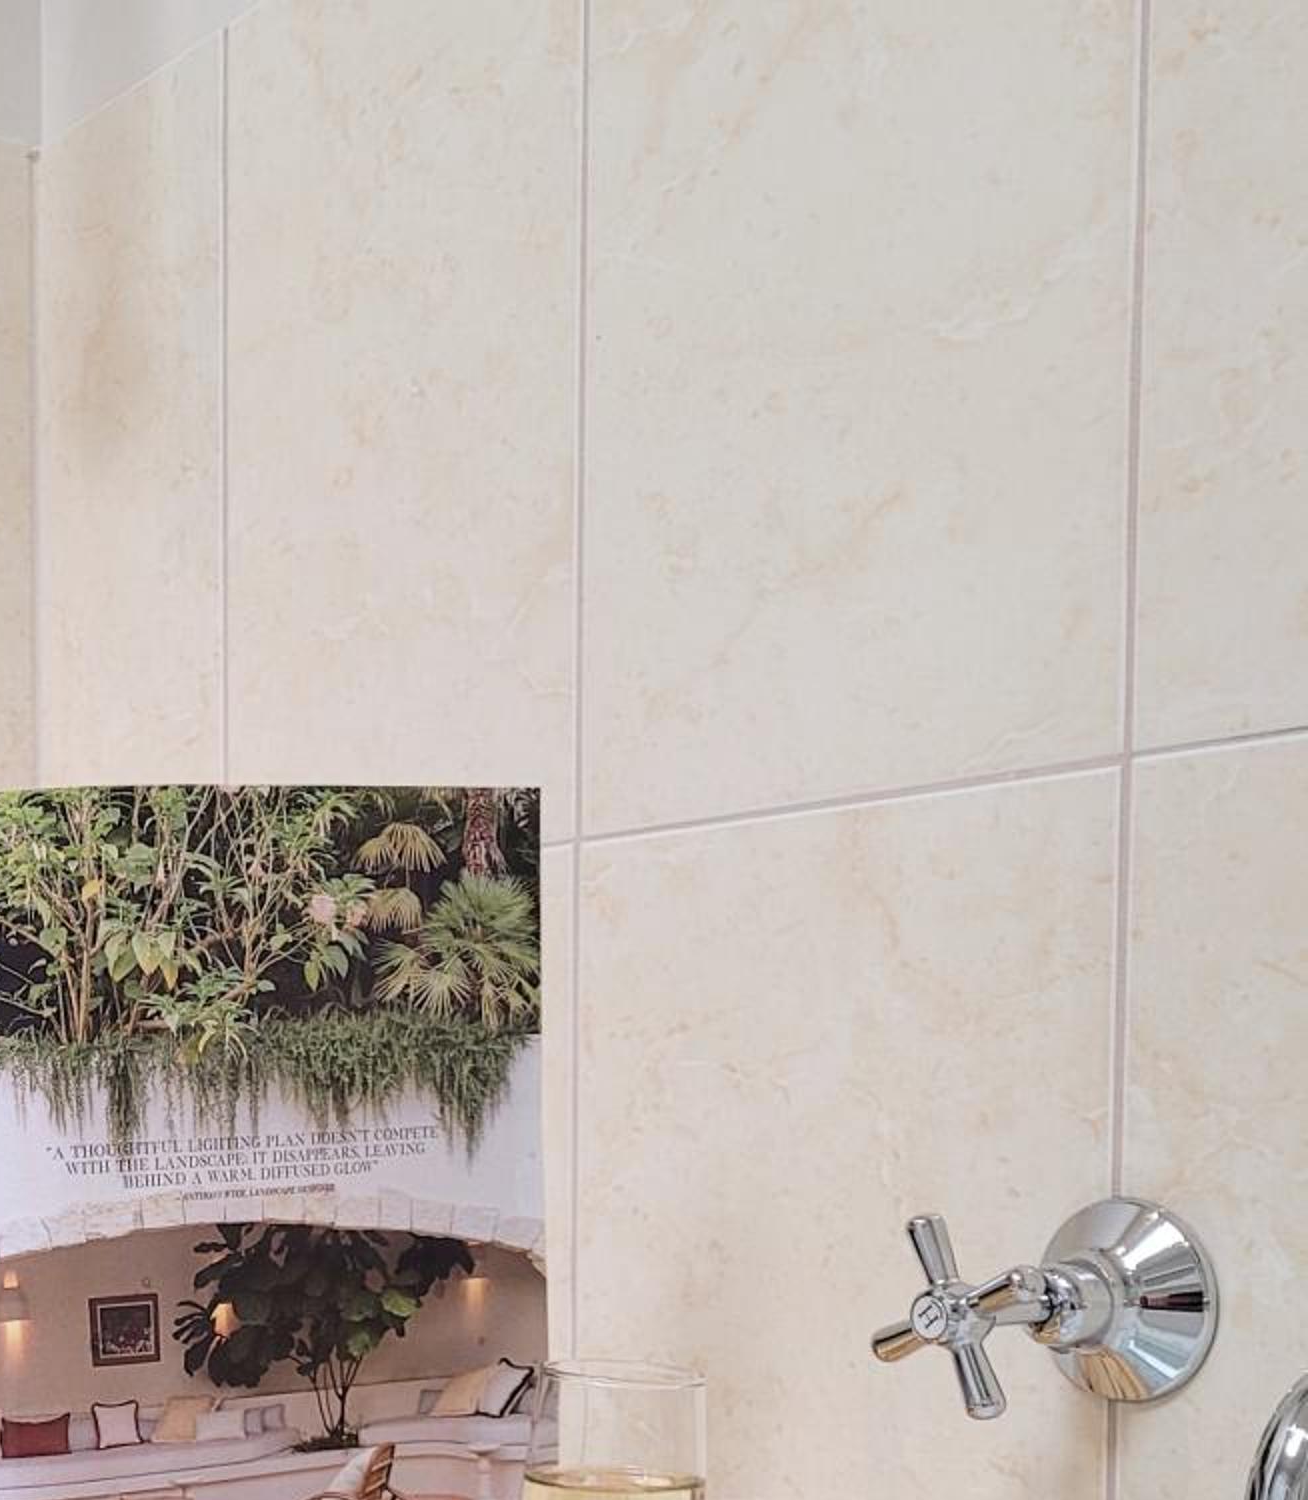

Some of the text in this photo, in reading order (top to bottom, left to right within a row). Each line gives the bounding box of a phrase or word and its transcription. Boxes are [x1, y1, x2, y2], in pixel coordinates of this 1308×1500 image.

[70, 1139, 182, 1159] THOUGHTFUL
[189, 1134, 261, 1153] LIGHTING
[265, 1132, 305, 1148] PLAN
[310, 1129, 370, 1146] DOESN'T
[373, 1126, 437, 1142] COMPETE
[65, 1160, 110, 1175] WITH
[116, 1157, 149, 1173] THE
[253, 1151, 267, 1165] IT
[364, 1142, 425, 1158] LEAVING
[122, 1172, 187, 1189] BEHIND
[192, 1172, 202, 1184] A
[261, 1163, 330, 1180] DIFFUSED
[918, 1305, 938, 1328] H
